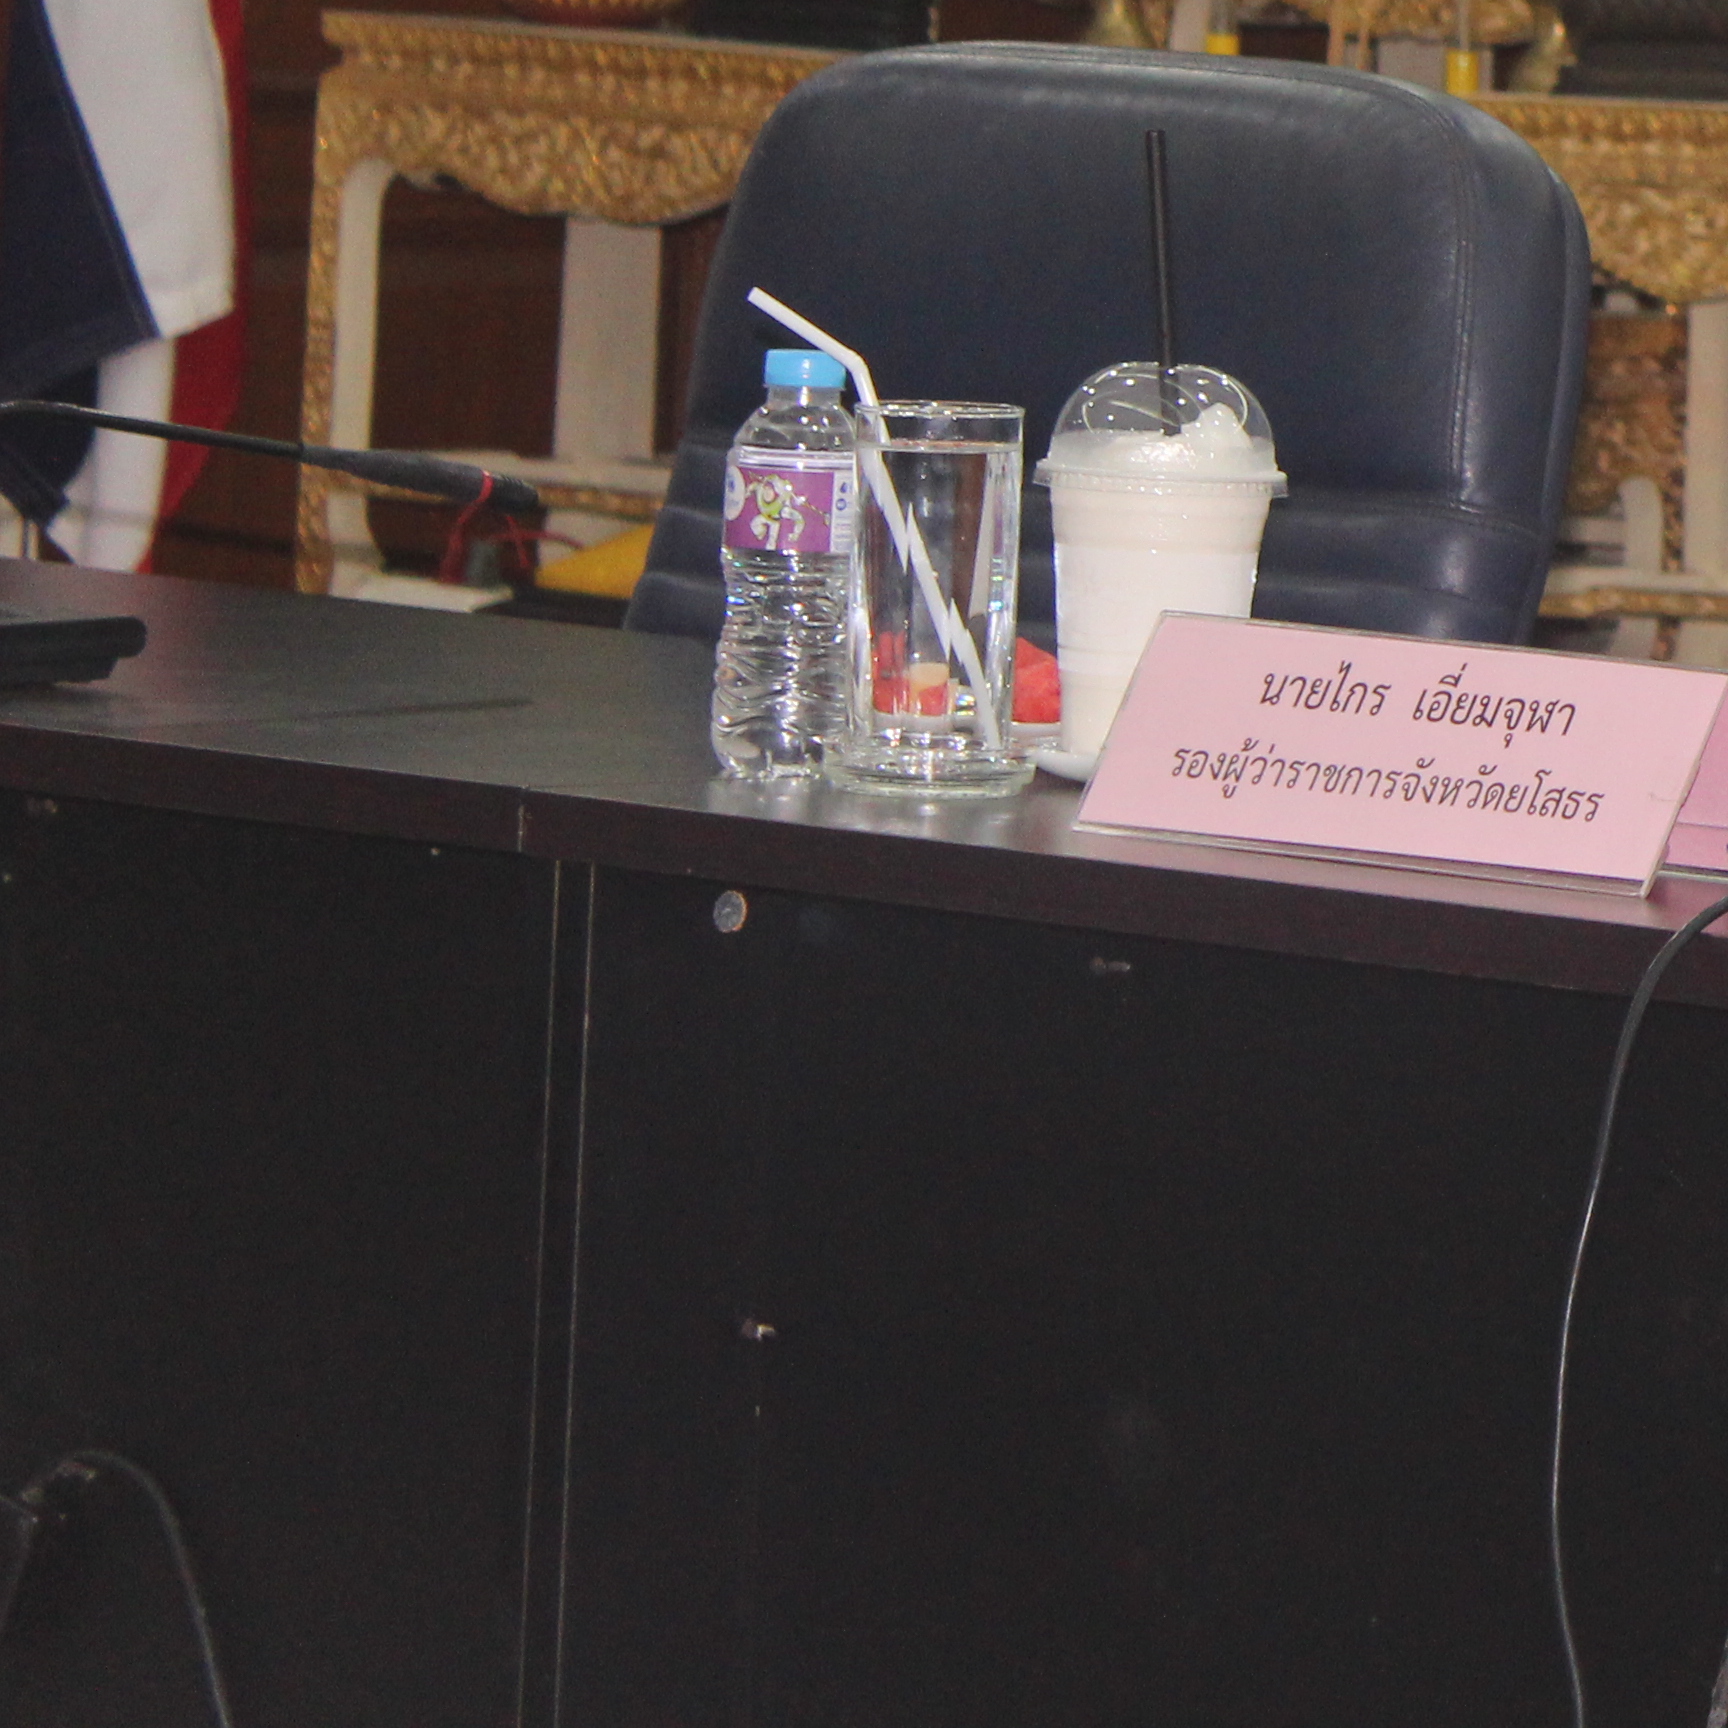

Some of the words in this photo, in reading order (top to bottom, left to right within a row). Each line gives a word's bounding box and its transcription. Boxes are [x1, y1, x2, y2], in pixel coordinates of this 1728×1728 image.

[1259, 660, 1391, 716] นายไกร
[1412, 663, 1577, 749] เอี่ยมจุฬา
[1172, 737, 1605, 822] รองผู้ว่าราชการจังหวัดยโสธร
